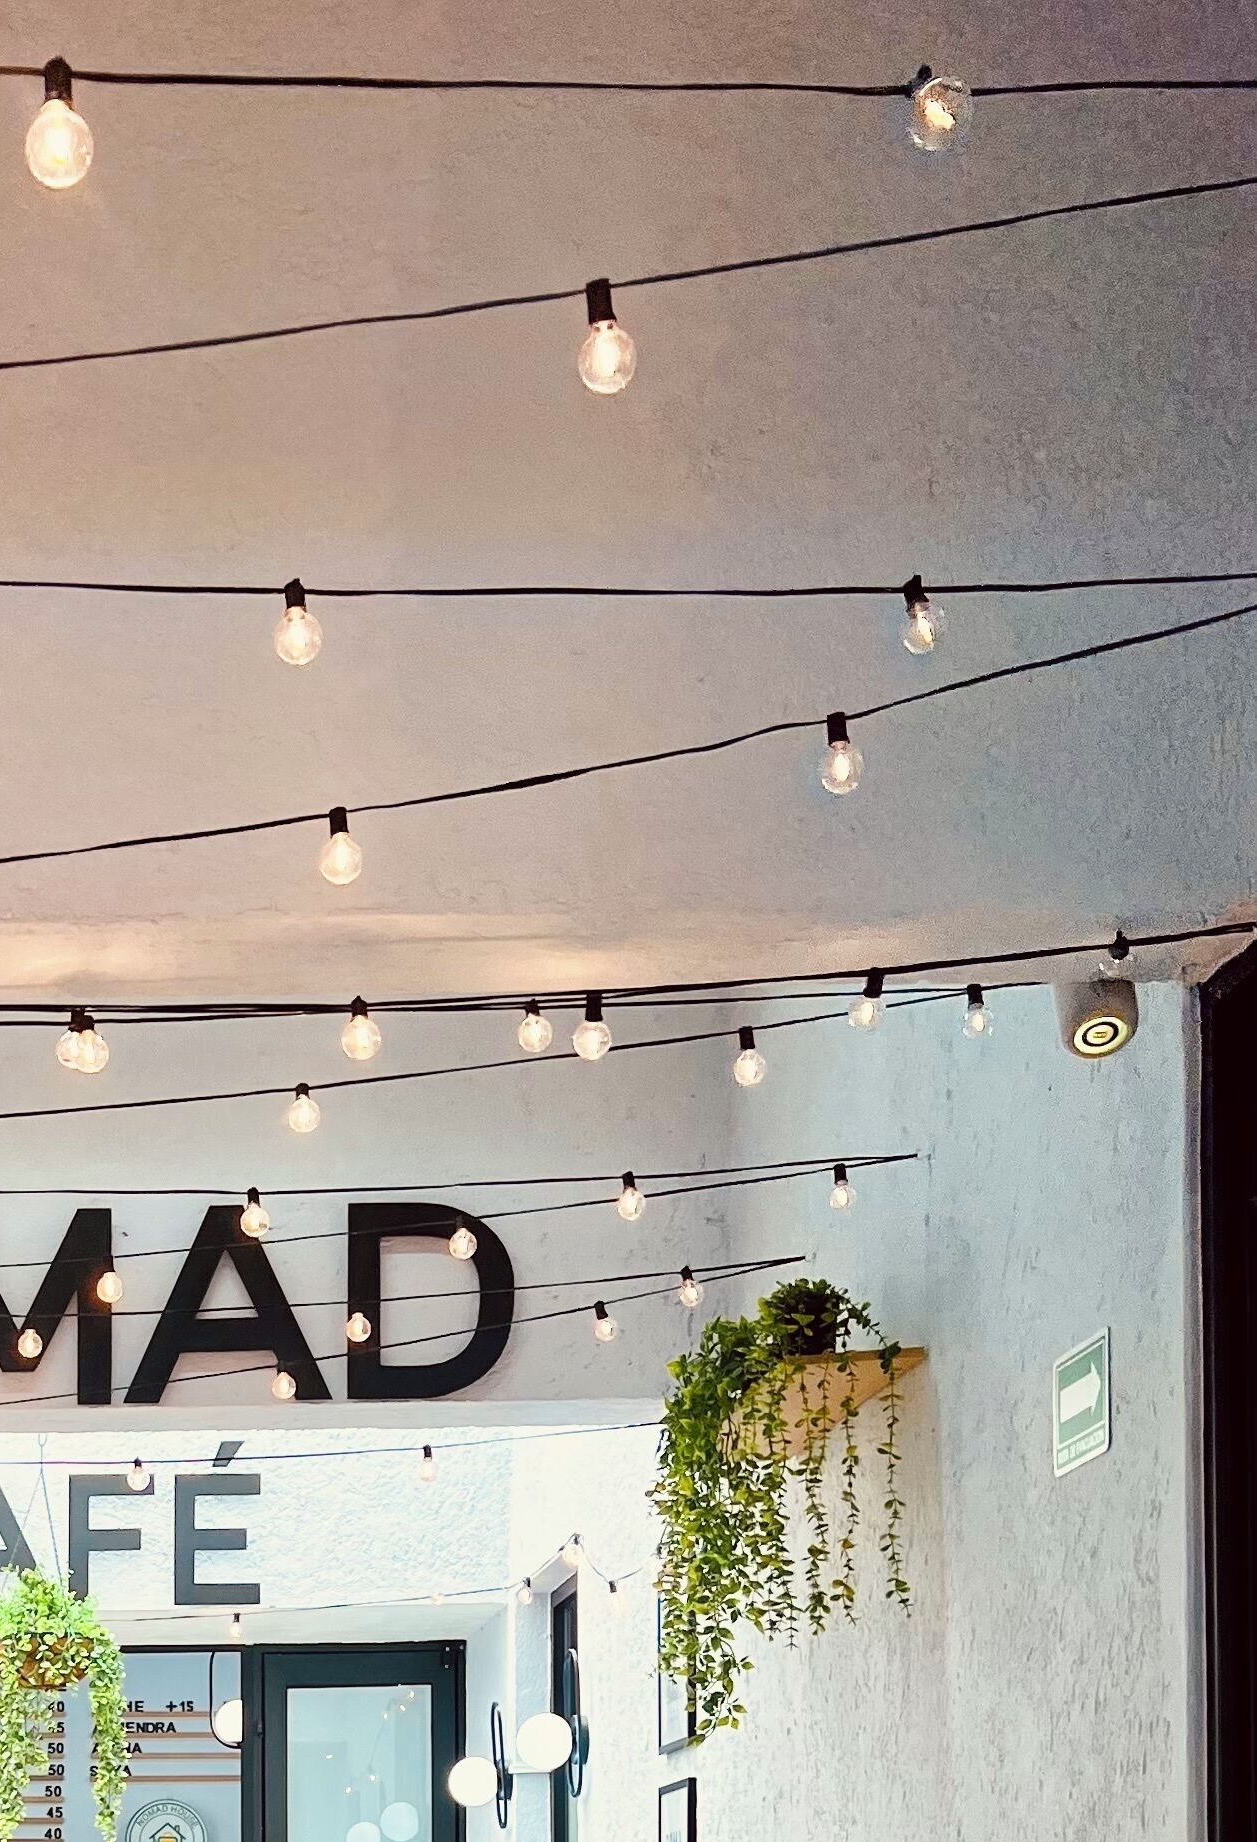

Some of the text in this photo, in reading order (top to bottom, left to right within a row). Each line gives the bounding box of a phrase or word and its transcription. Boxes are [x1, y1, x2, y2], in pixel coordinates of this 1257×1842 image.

[165, 1701, 194, 1713] +15
[48, 1743, 64, 1754] 50
[48, 1764, 64, 1776] 50
[45, 1785, 61, 1797] 50
[46, 1806, 63, 1818] 45
[136, 1805, 168, 1827] NOMAD
[44, 1828, 62, 1840] 40
